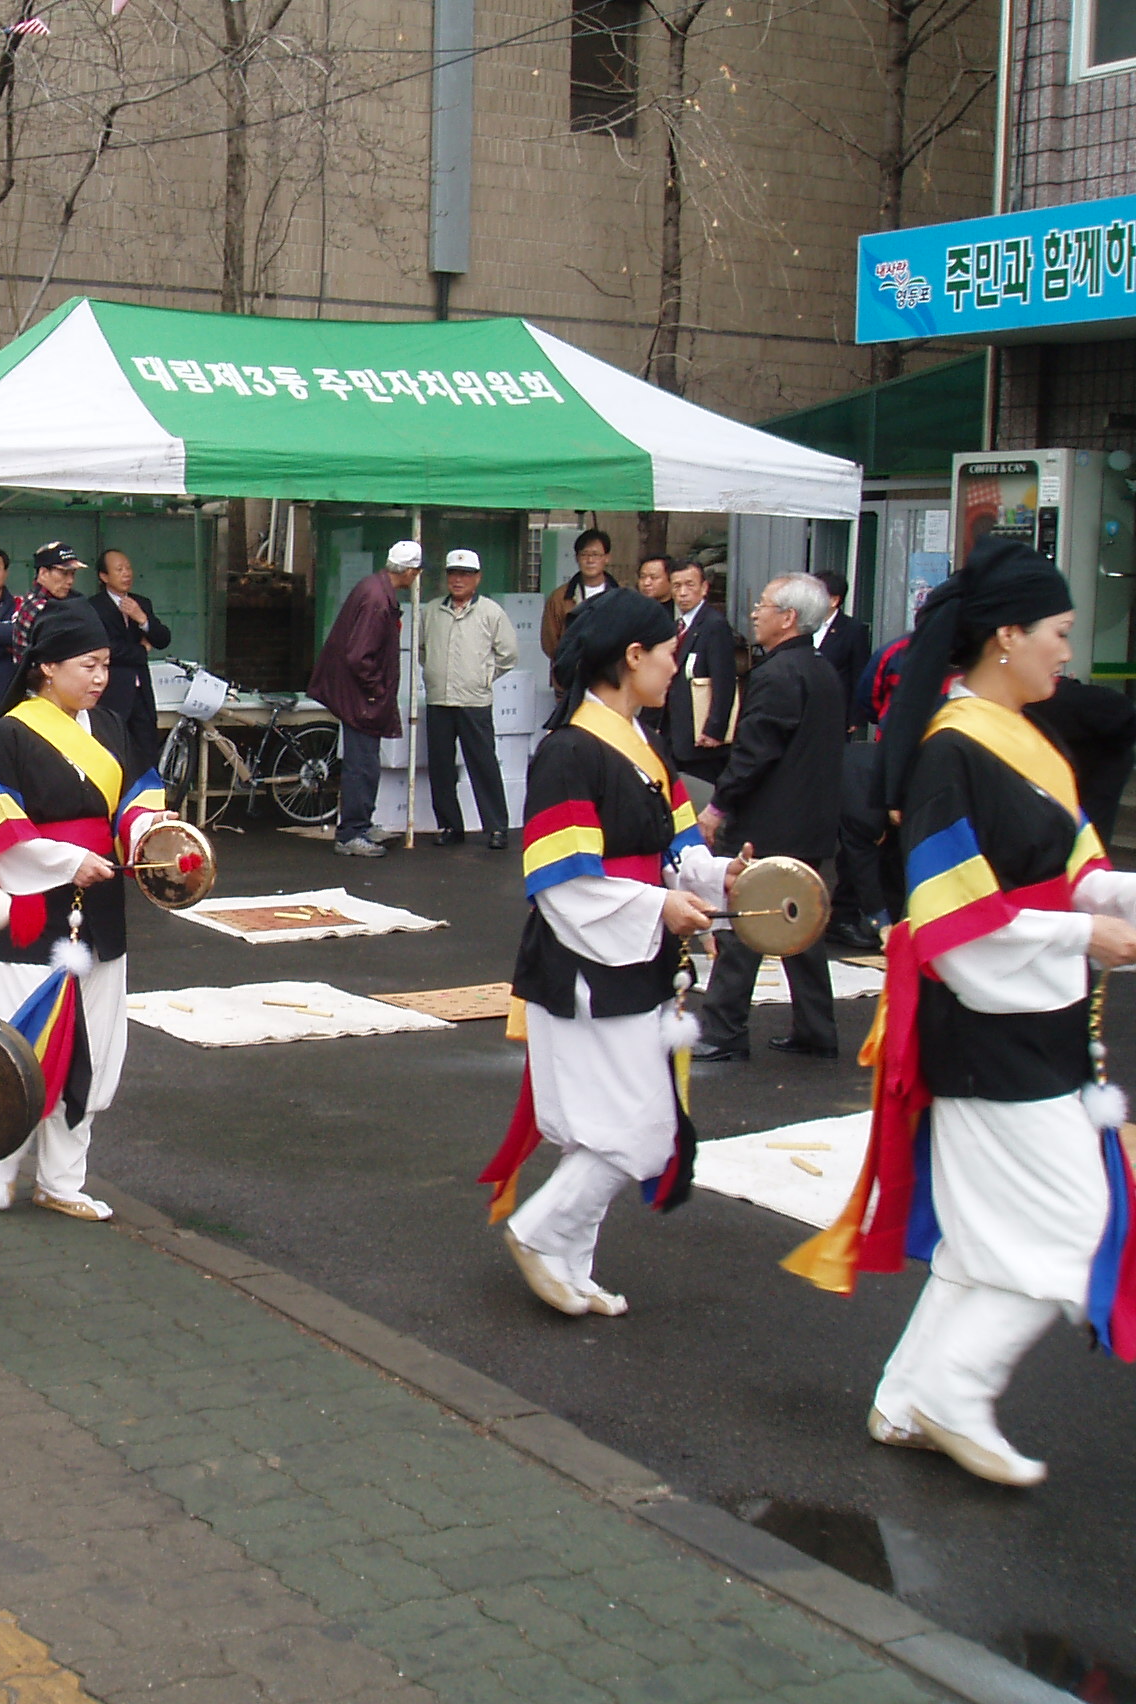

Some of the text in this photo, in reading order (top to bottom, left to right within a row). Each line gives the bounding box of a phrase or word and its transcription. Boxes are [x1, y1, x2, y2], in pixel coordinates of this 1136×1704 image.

[945, 235, 1034, 313] 주민과
[895, 285, 932, 309] 영등포
[130, 355, 565, 406] 대림제3동 주민자치위원회
[1007, 462, 1027, 473] CAN
